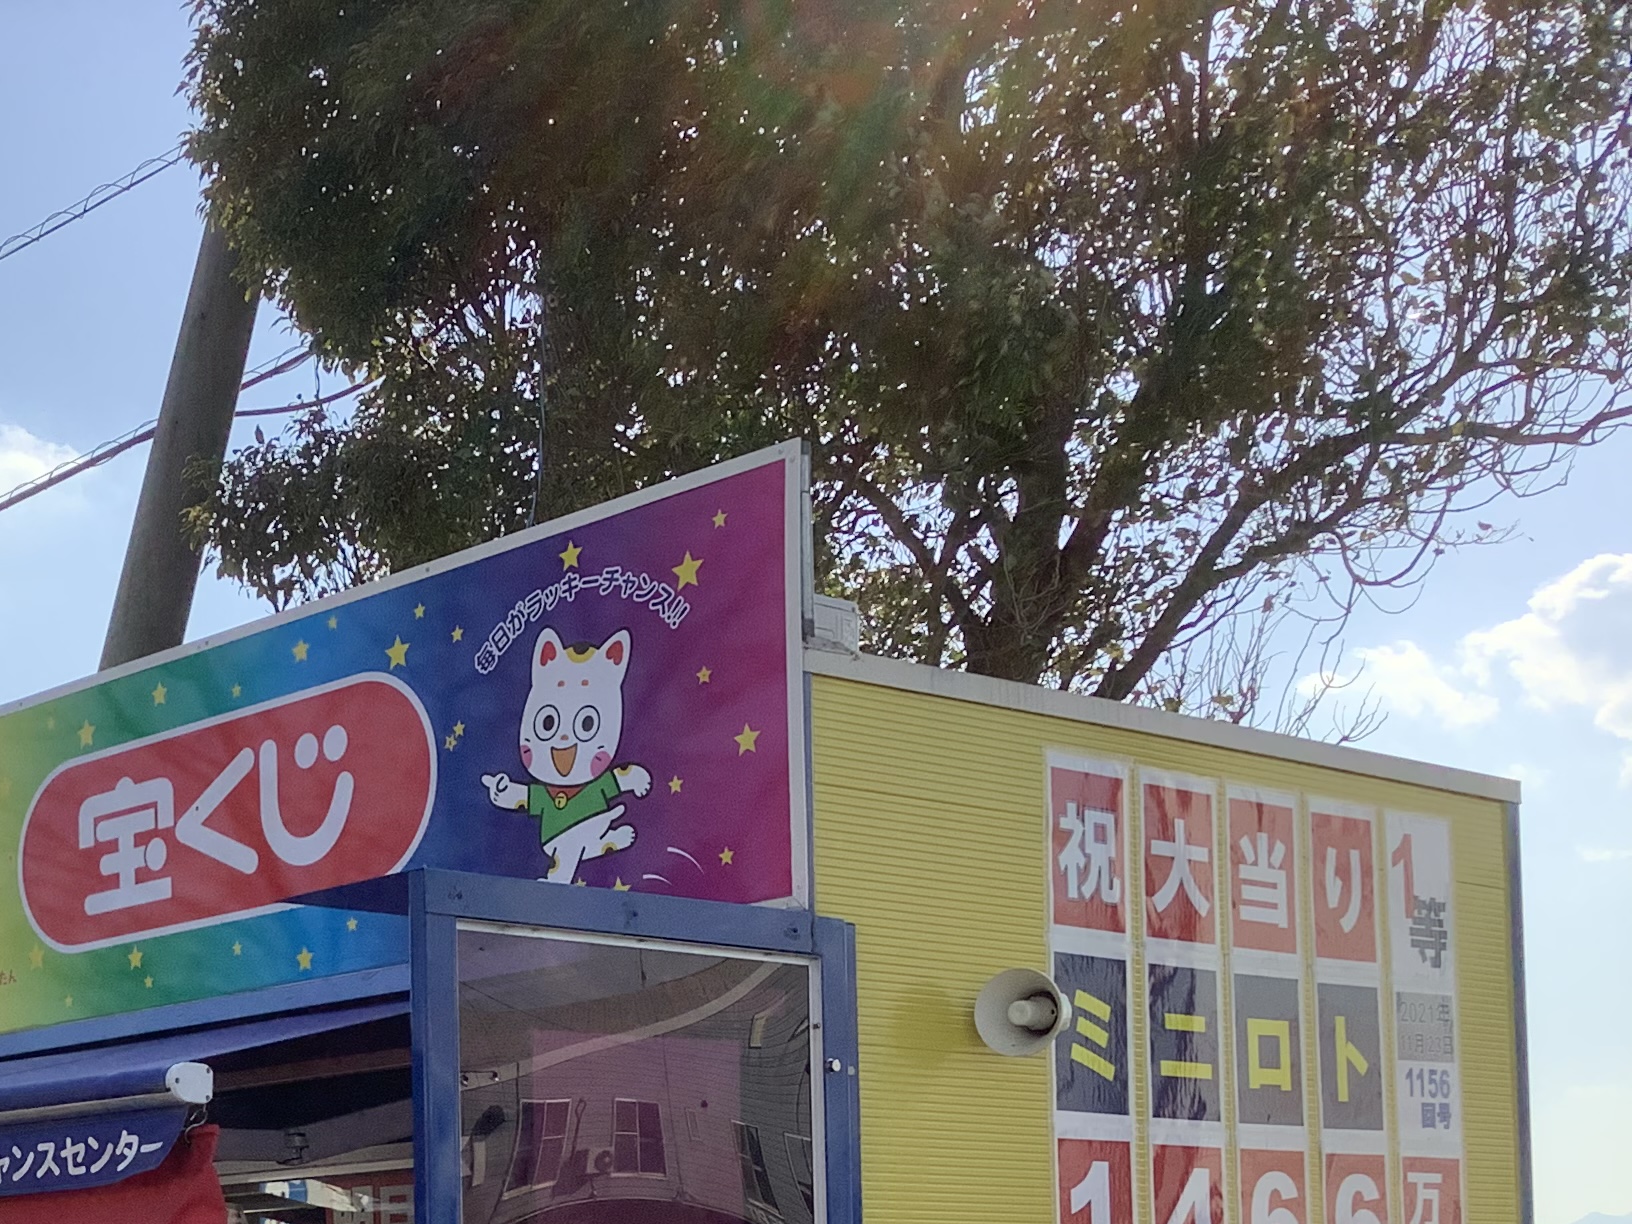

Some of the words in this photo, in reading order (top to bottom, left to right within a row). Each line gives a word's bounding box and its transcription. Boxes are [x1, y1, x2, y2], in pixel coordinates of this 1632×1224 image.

[77, 724, 354, 916] 宝くじ
[1058, 802, 1361, 934] 祝大当り
[1070, 988, 1369, 1104] ミニロト
[1405, 1067, 1451, 1099] 1156
